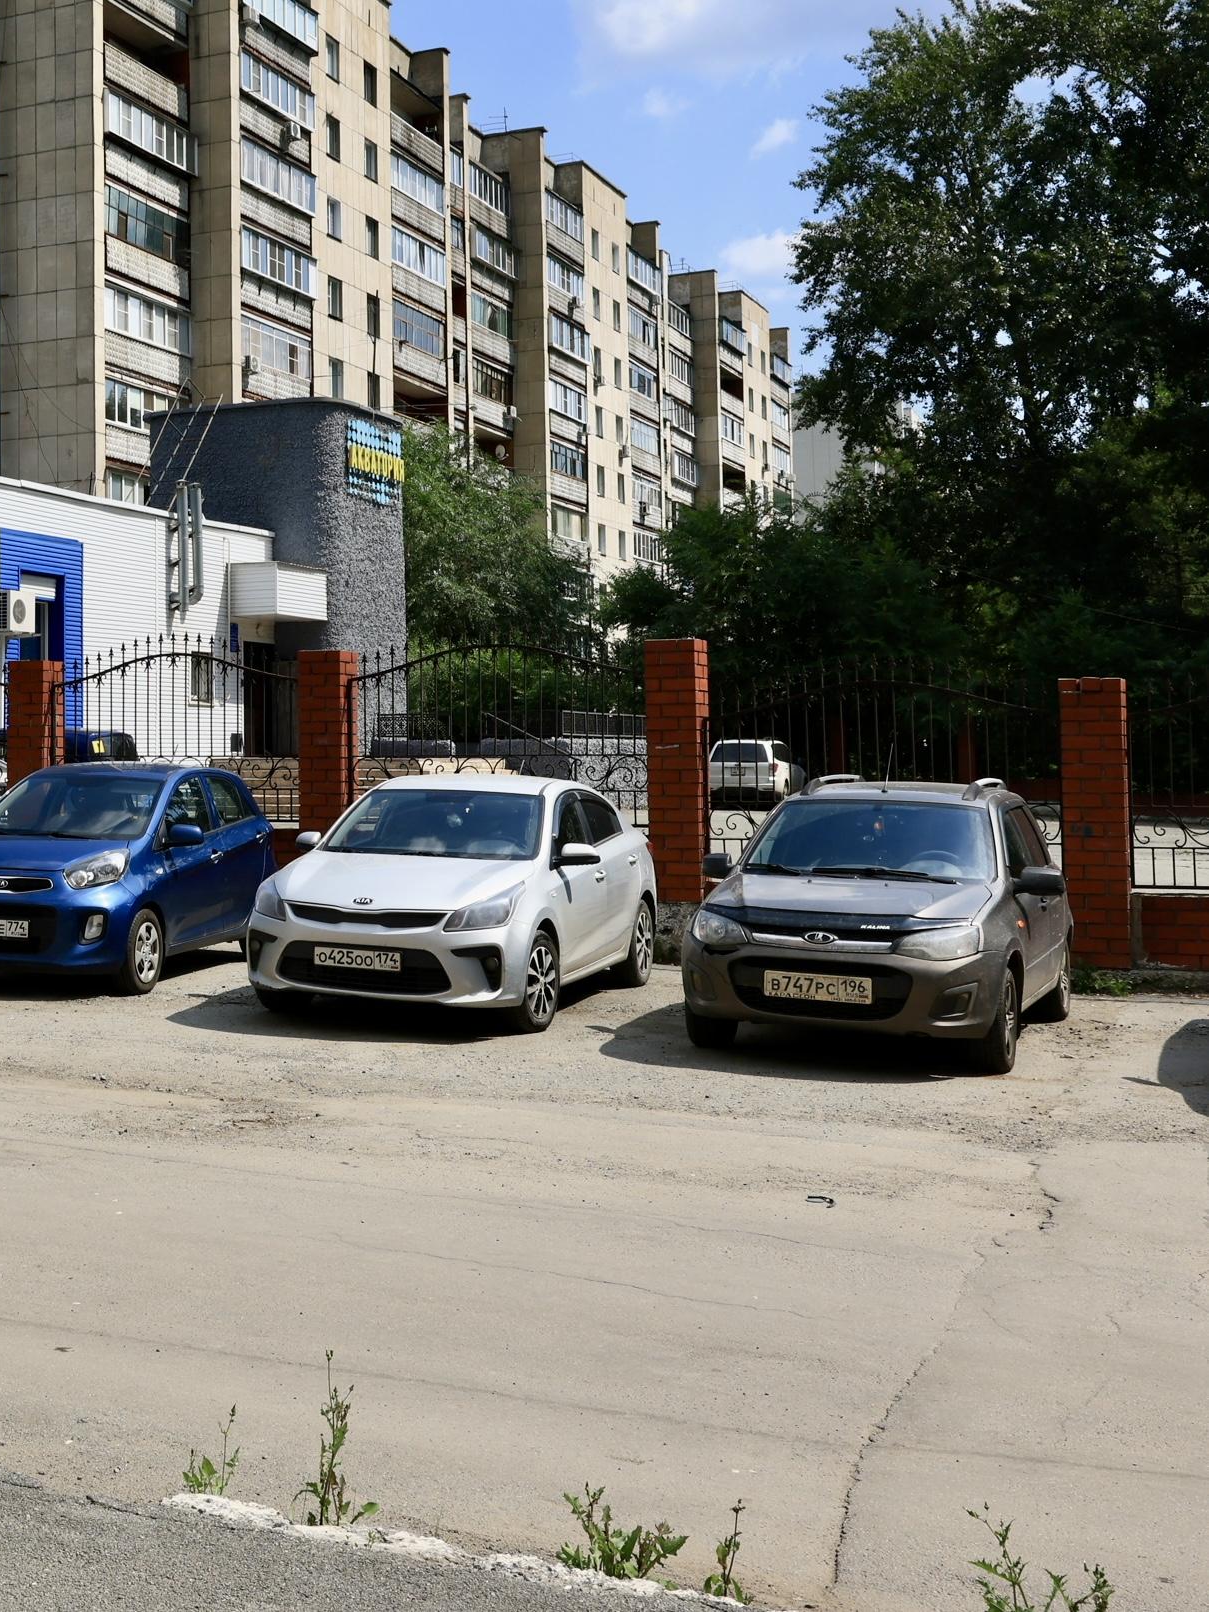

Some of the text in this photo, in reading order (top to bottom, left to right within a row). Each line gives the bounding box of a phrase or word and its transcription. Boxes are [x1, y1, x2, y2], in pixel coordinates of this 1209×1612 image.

[351, 445, 405, 482] АКВАТОРИЯ
[7, 921, 25, 932] 774
[318, 949, 397, 967] О425ОО 174
[771, 975, 866, 995] В747РС 196
